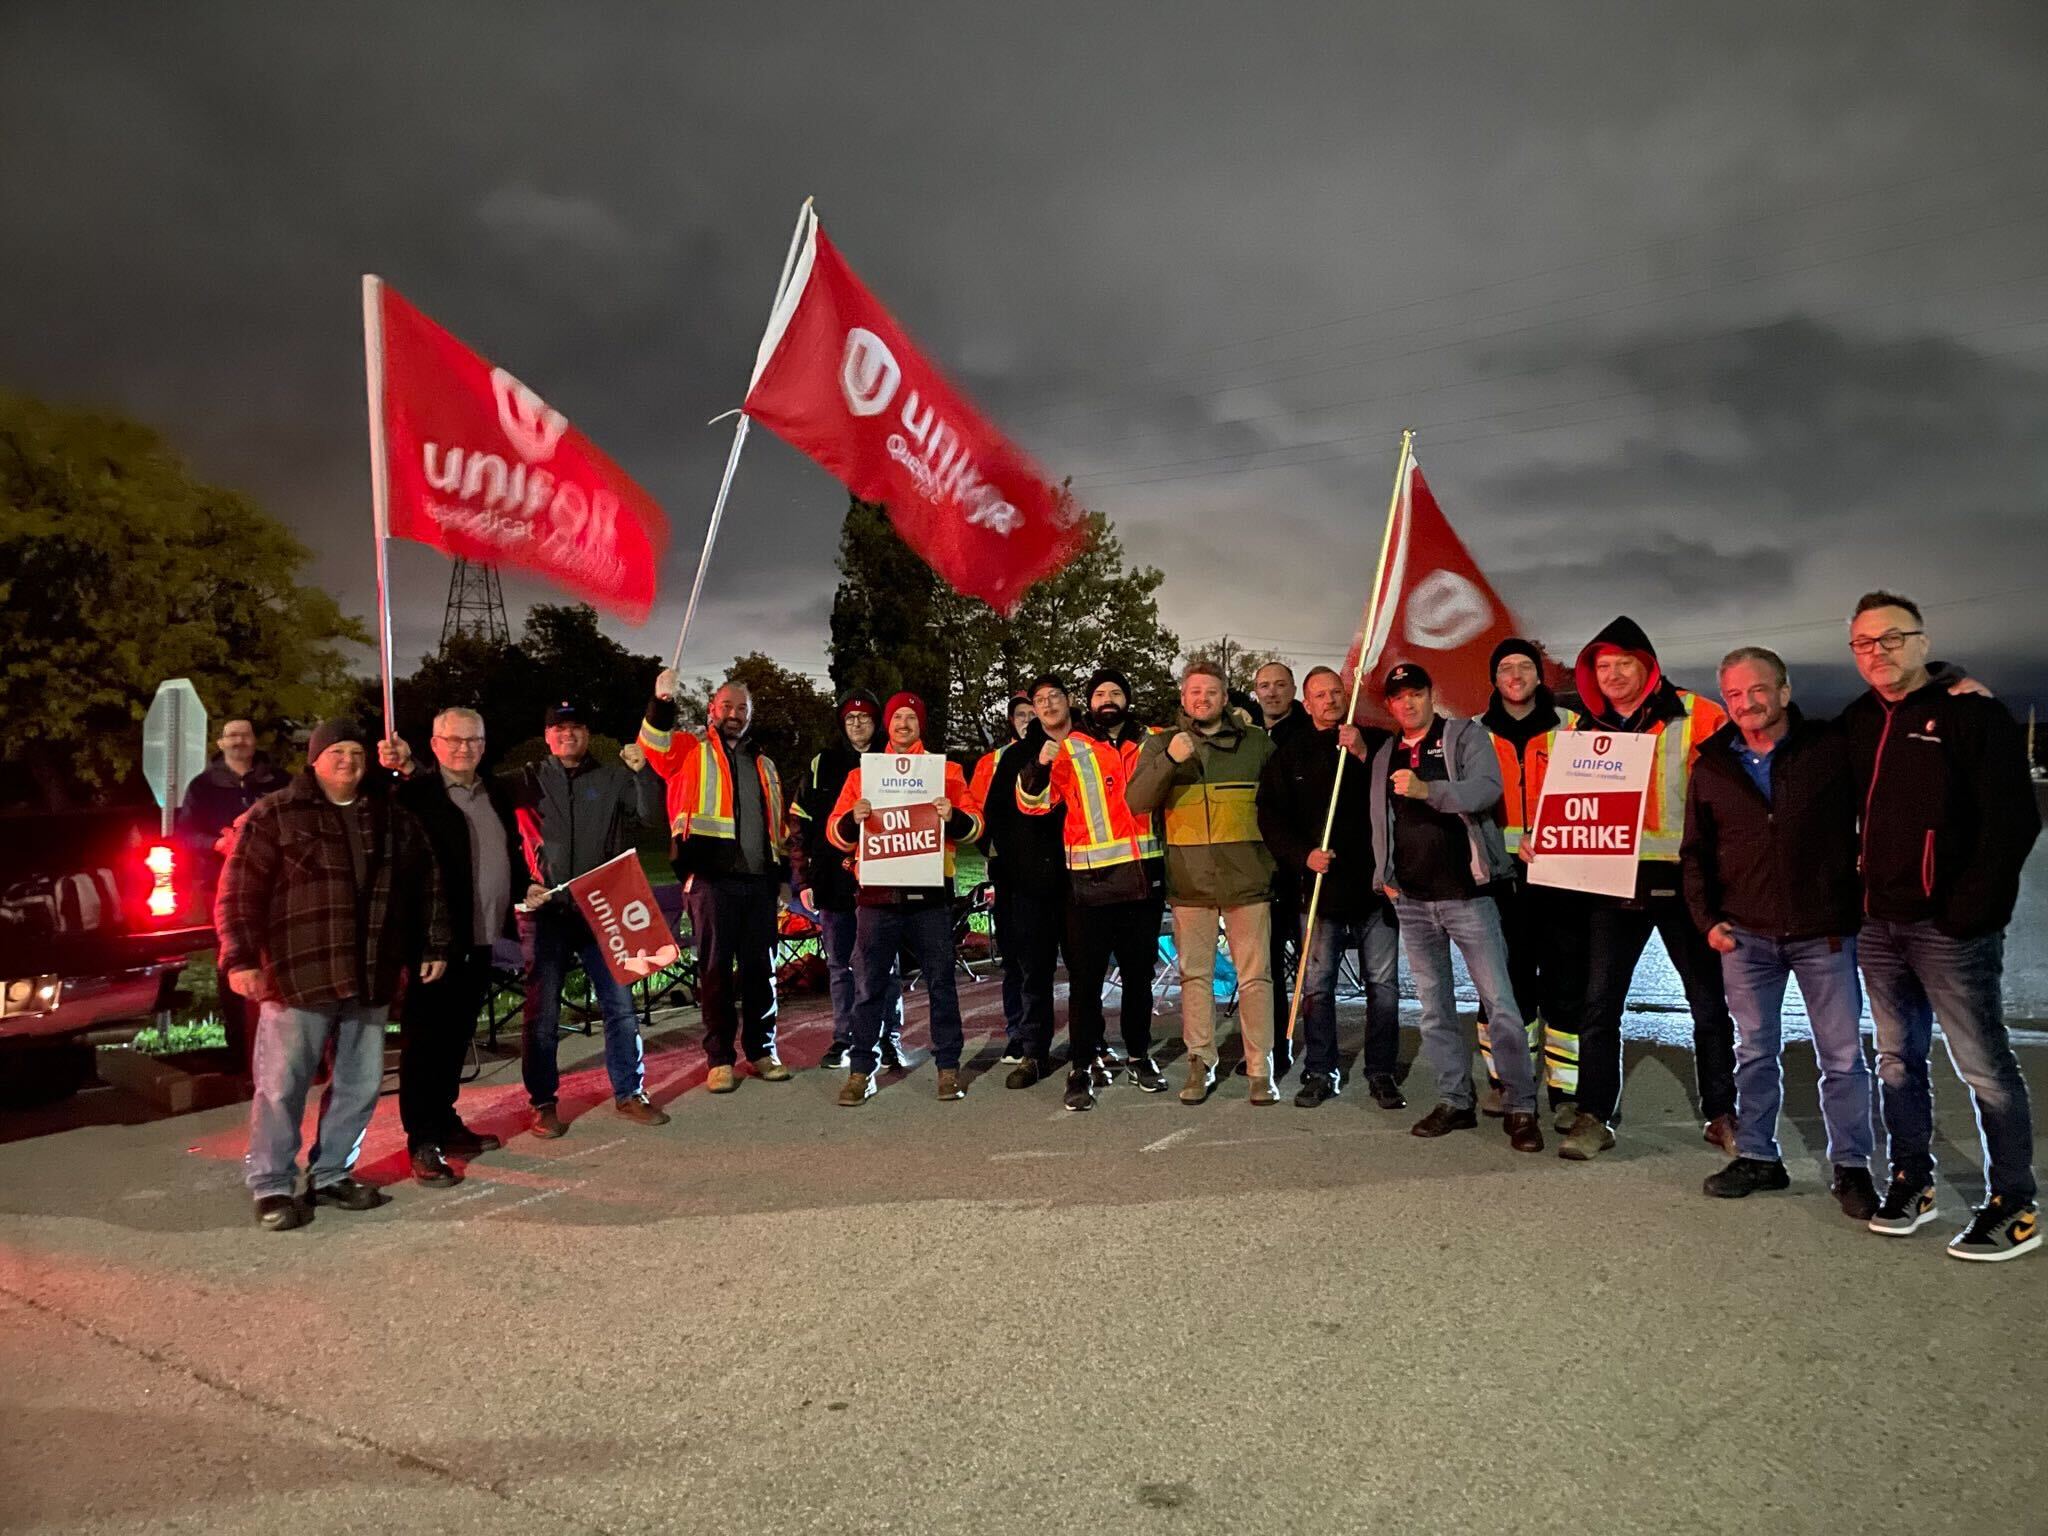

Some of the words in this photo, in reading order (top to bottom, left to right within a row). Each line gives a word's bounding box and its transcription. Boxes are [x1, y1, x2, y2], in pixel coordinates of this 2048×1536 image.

[1573, 759, 1623, 772] UNIFOR
[882, 778, 923, 787] UNIFOR
[883, 809, 910, 831] ON
[1564, 797, 1599, 821] ON
[867, 829, 937, 856] STRIKE
[1541, 825, 1630, 849] STRIKE
[587, 890, 629, 966] UNIFOR
